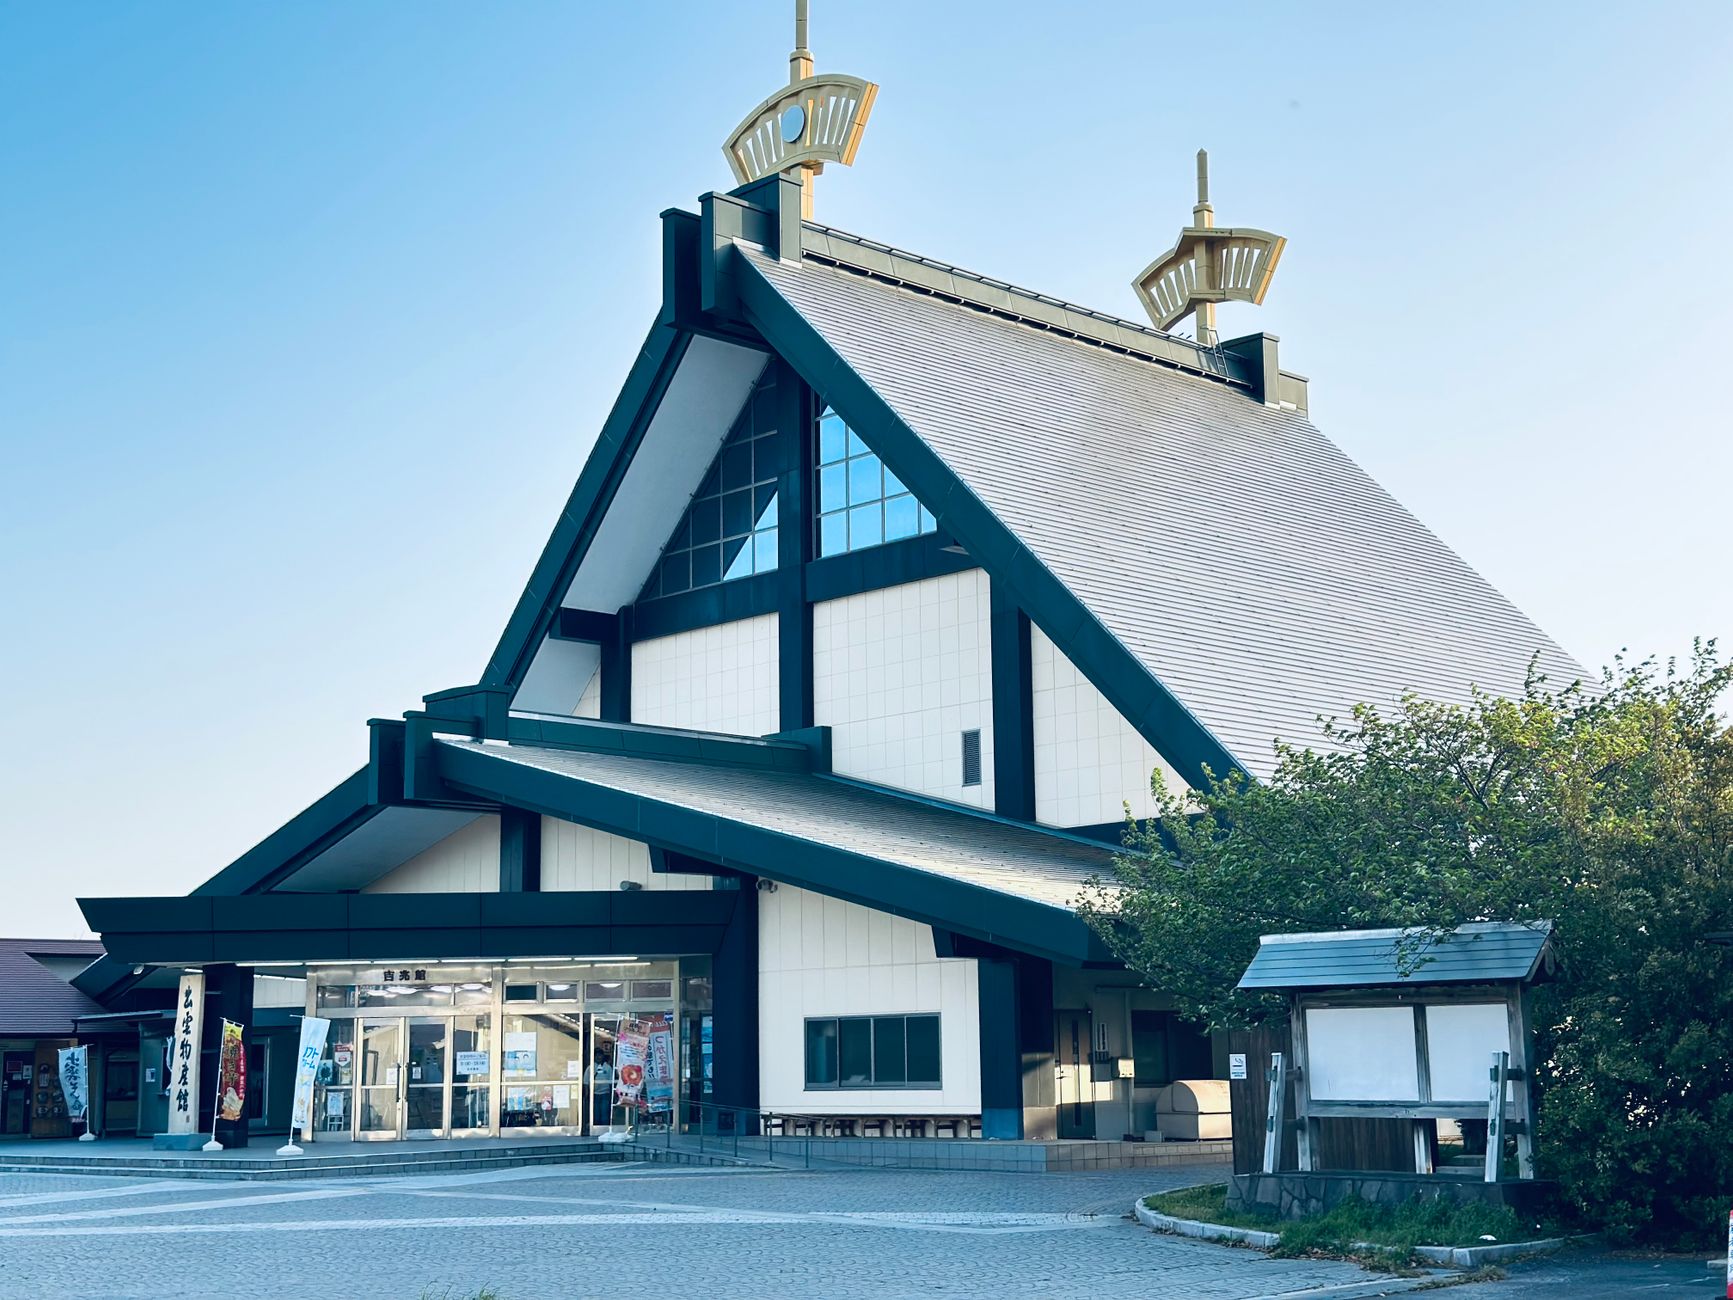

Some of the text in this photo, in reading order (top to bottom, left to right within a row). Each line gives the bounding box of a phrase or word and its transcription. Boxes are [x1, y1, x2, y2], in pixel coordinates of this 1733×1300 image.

[176, 985, 194, 1113] 出雲物産館
